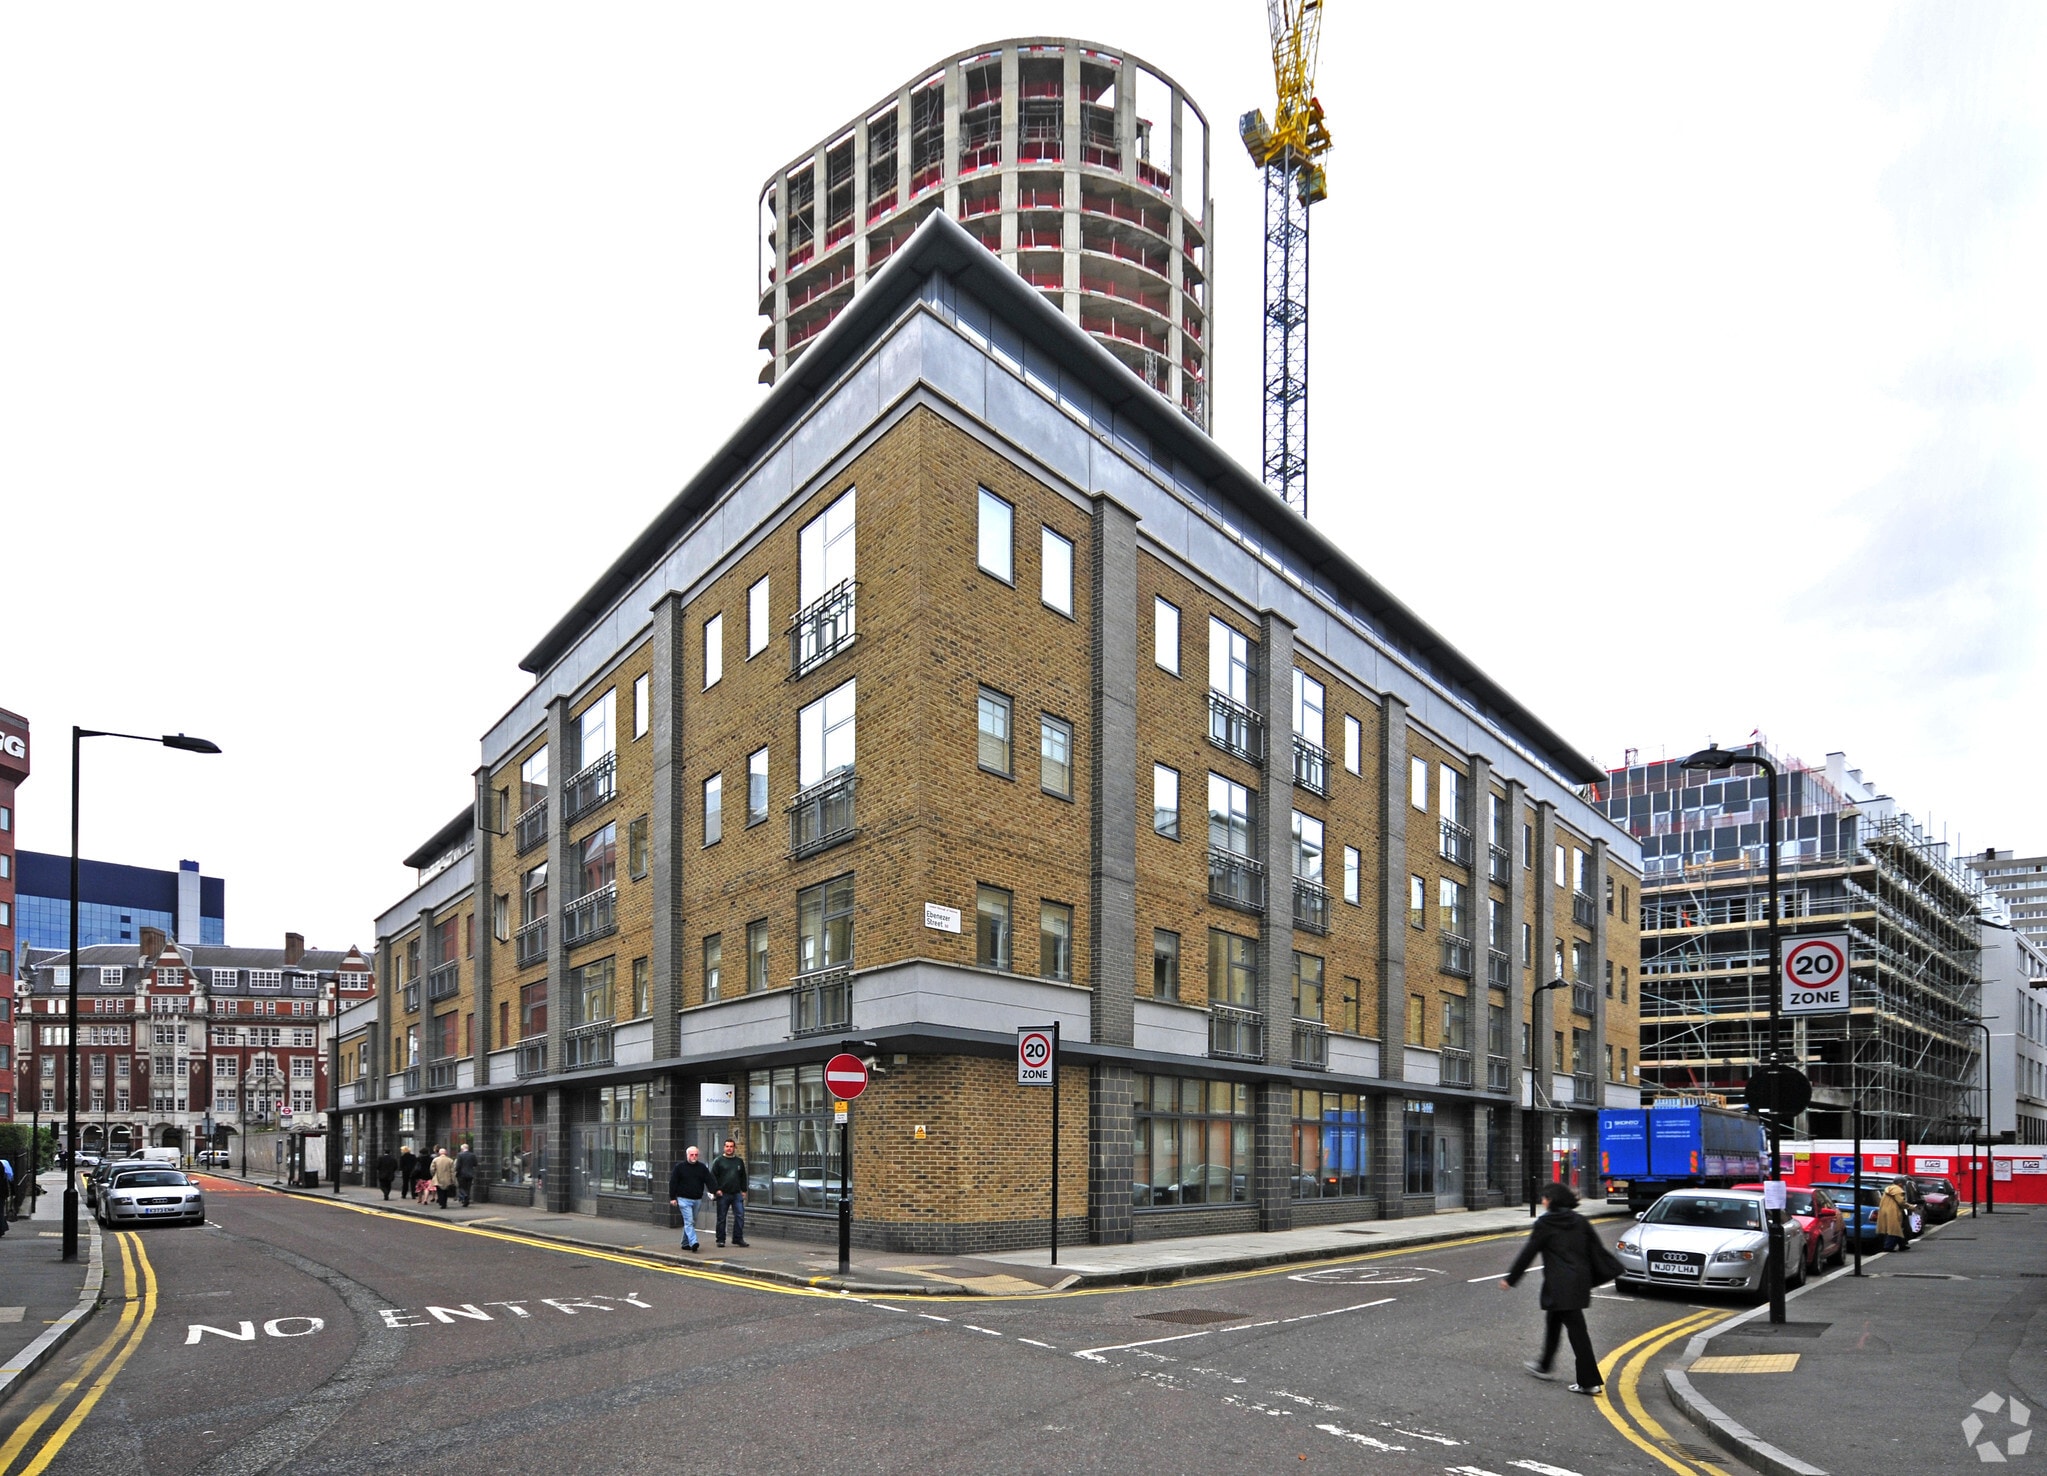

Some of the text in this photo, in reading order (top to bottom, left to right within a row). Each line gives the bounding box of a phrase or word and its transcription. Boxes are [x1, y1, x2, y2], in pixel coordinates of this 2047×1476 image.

[927, 911, 950, 921] Ebenezer
[927, 918, 943, 928] Street
[1796, 955, 1833, 975] 20
[1790, 991, 1840, 1005] ZONE
[1026, 1044, 1045, 1057] 20
[1022, 1070, 1048, 1078] ZONE
[1655, 1264, 1694, 1273] NJ07 LHA
[185, 1292, 652, 1345] NO ENTRY
